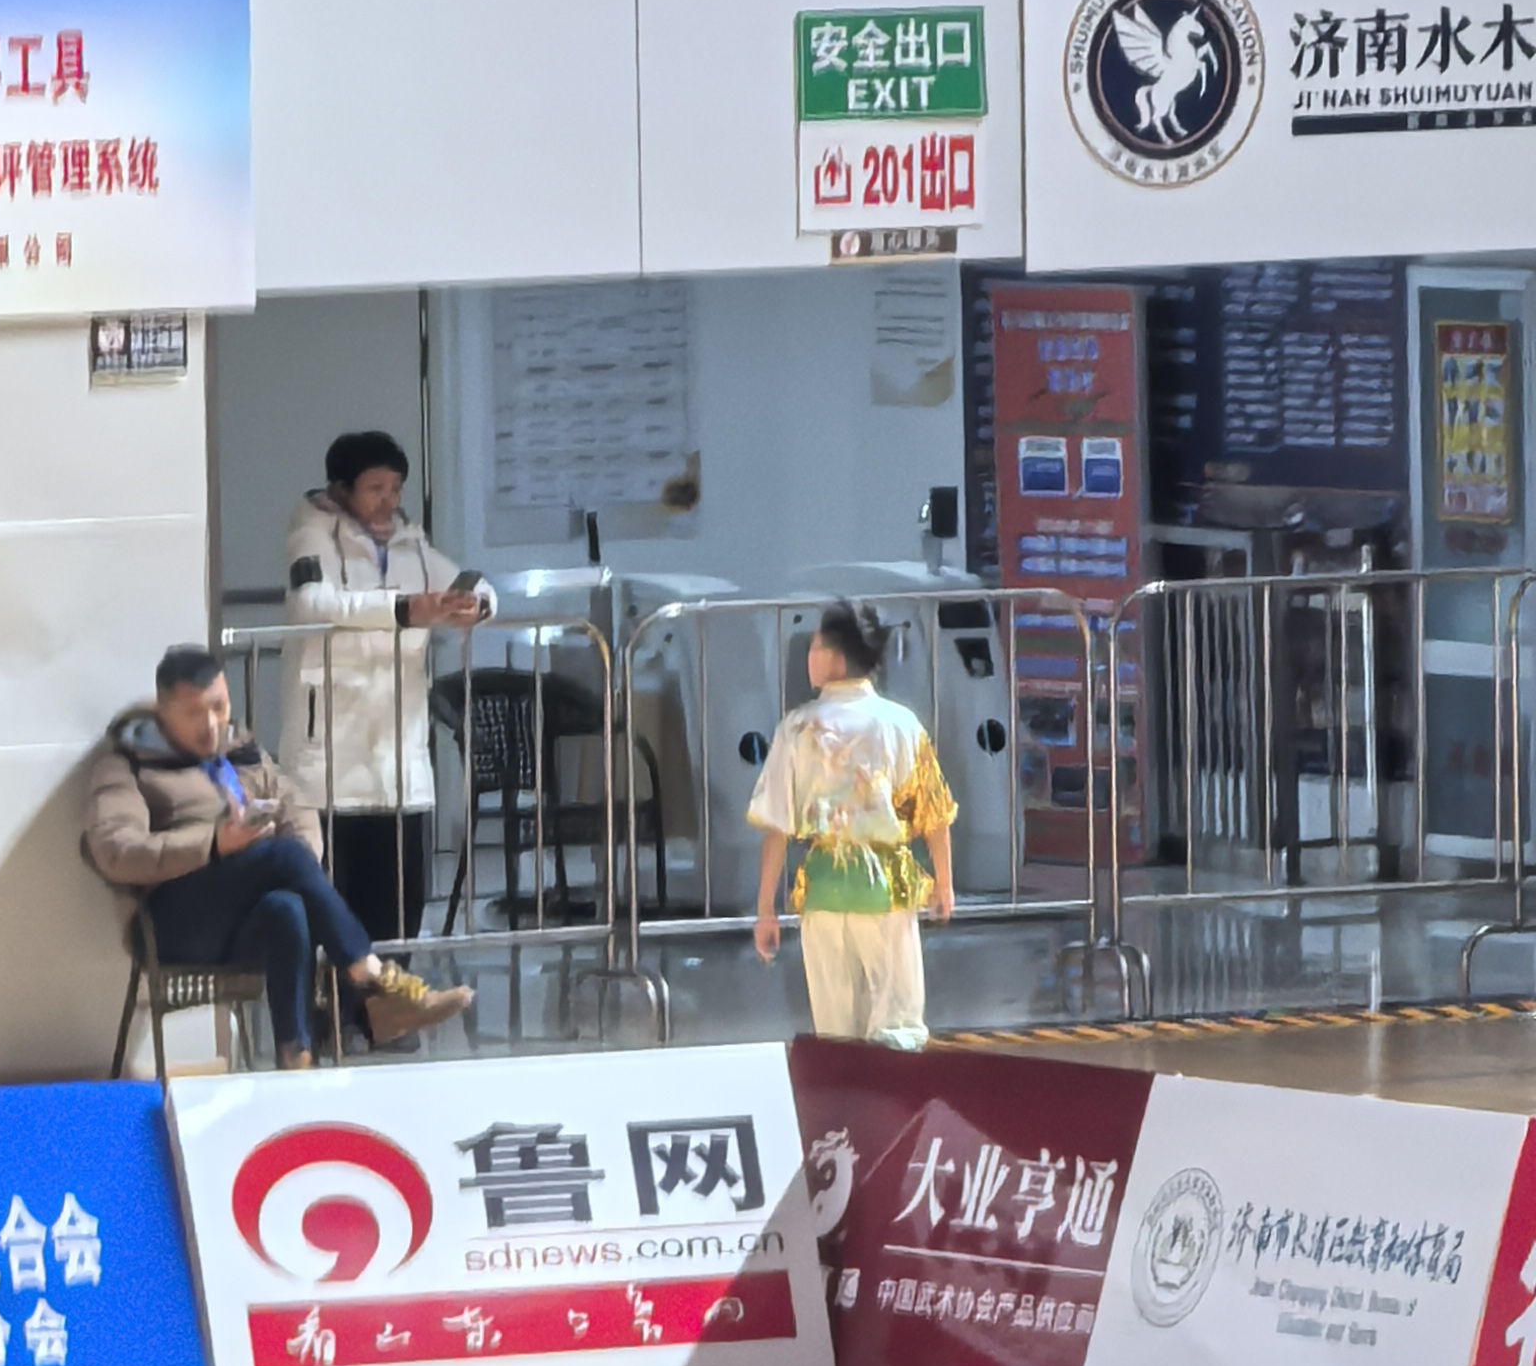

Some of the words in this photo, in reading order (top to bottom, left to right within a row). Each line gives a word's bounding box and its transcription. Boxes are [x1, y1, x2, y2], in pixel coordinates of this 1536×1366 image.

[811, 18, 972, 76] 安全出口
[1289, 3, 1536, 79] 济南水木
[847, 75, 937, 112] EXIT
[1379, 81, 1533, 109] SHUIMUYUAN
[454, 1115, 766, 1230] 鲁网
[892, 1137, 1119, 1247] 大业亨通
[464, 1230, 786, 1273] sdnews.com.cn
